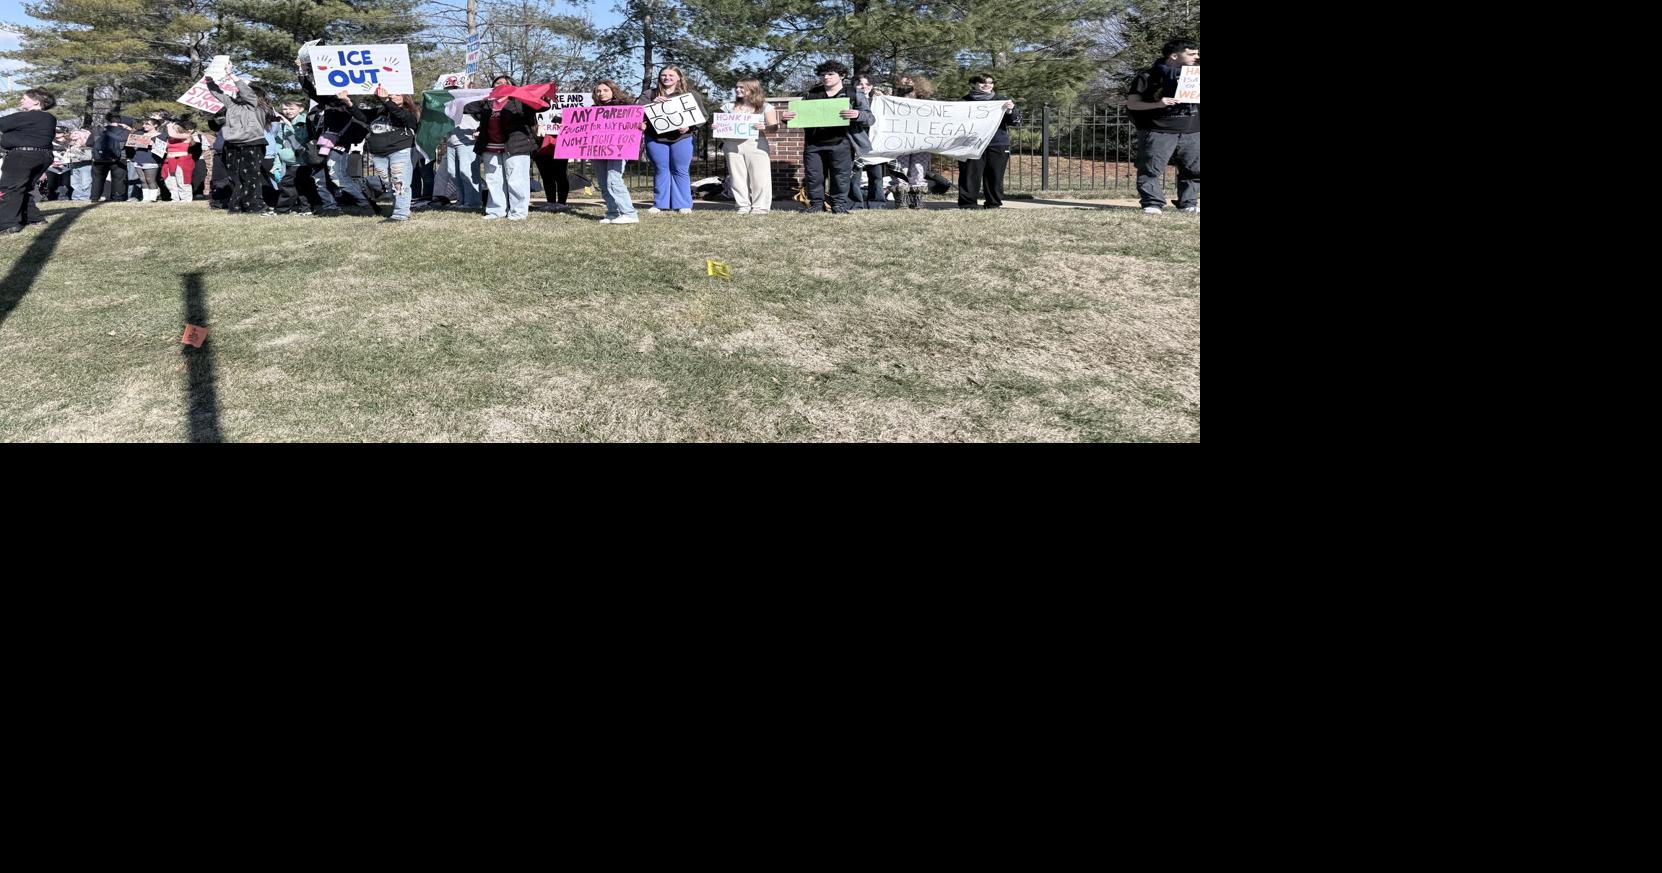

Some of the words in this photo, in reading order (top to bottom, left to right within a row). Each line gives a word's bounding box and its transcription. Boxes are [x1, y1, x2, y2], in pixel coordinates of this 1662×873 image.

[337, 50, 373, 67] ICE
[327, 68, 380, 88] OUT
[185, 97, 221, 112] LAND
[566, 94, 584, 103] AND
[645, 94, 697, 119] ICE
[882, 100, 912, 117] NO
[916, 104, 953, 118] ONE
[967, 105, 990, 120] IS
[570, 108, 593, 124] MY
[653, 106, 697, 131] OUT
[716, 113, 742, 121] HONK
[560, 123, 588, 136] FOUGHT
[604, 121, 618, 131] MY
[618, 121, 643, 131] FUTUR
[734, 122, 758, 137] ICE
[881, 118, 978, 137] ILLEGAL
[561, 136, 581, 147] NOW
[591, 133, 614, 145] FIGHT
[617, 133, 636, 145] FOR
[884, 136, 916, 151] ON
